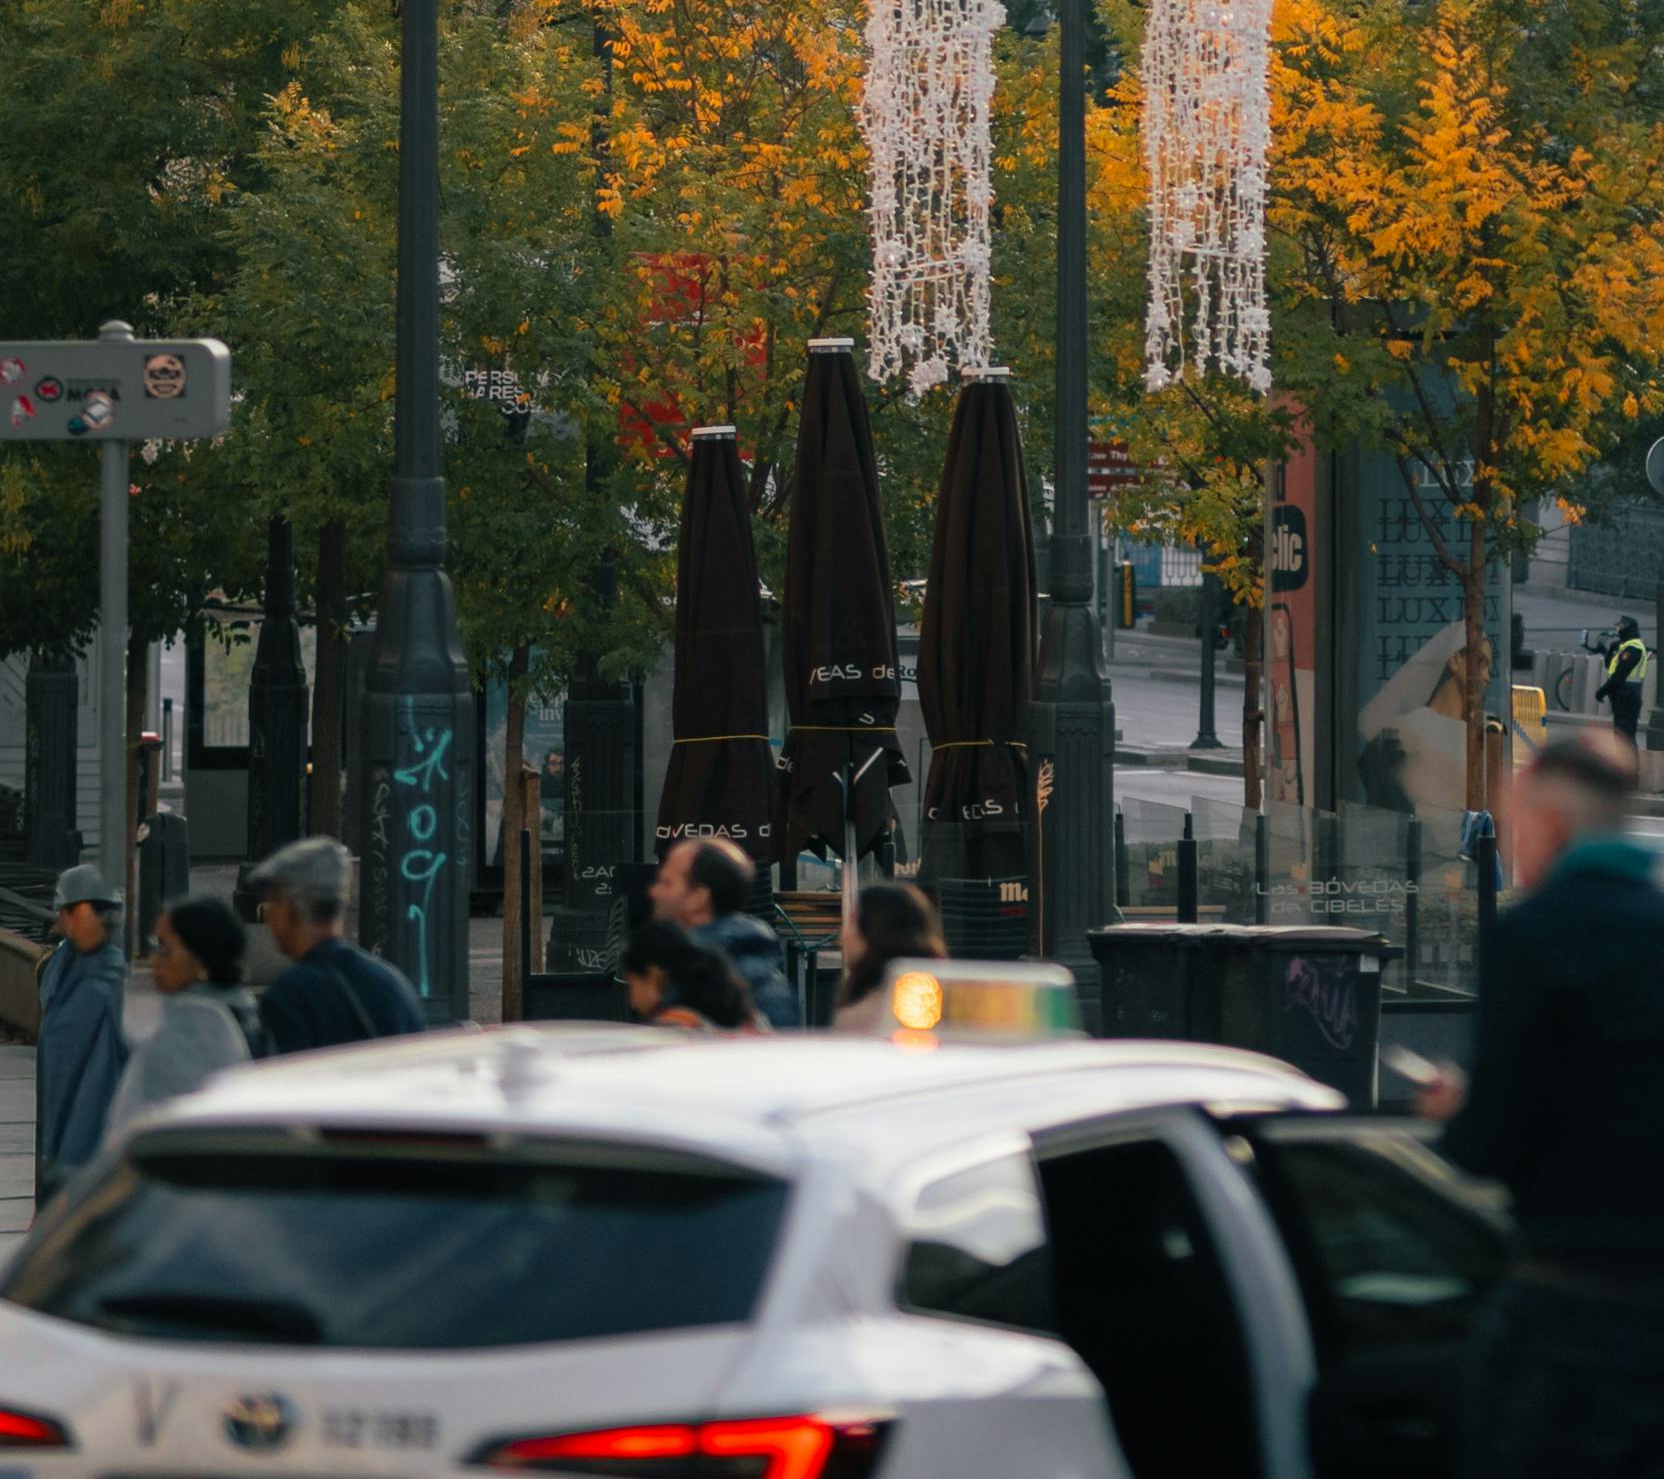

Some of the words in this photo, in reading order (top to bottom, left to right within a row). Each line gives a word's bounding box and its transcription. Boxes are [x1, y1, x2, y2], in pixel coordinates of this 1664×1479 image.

[1378, 597, 1450, 624] LUX
[1309, 876, 1421, 895] BÓVEDAS
[1309, 898, 1406, 914] CIBELES
